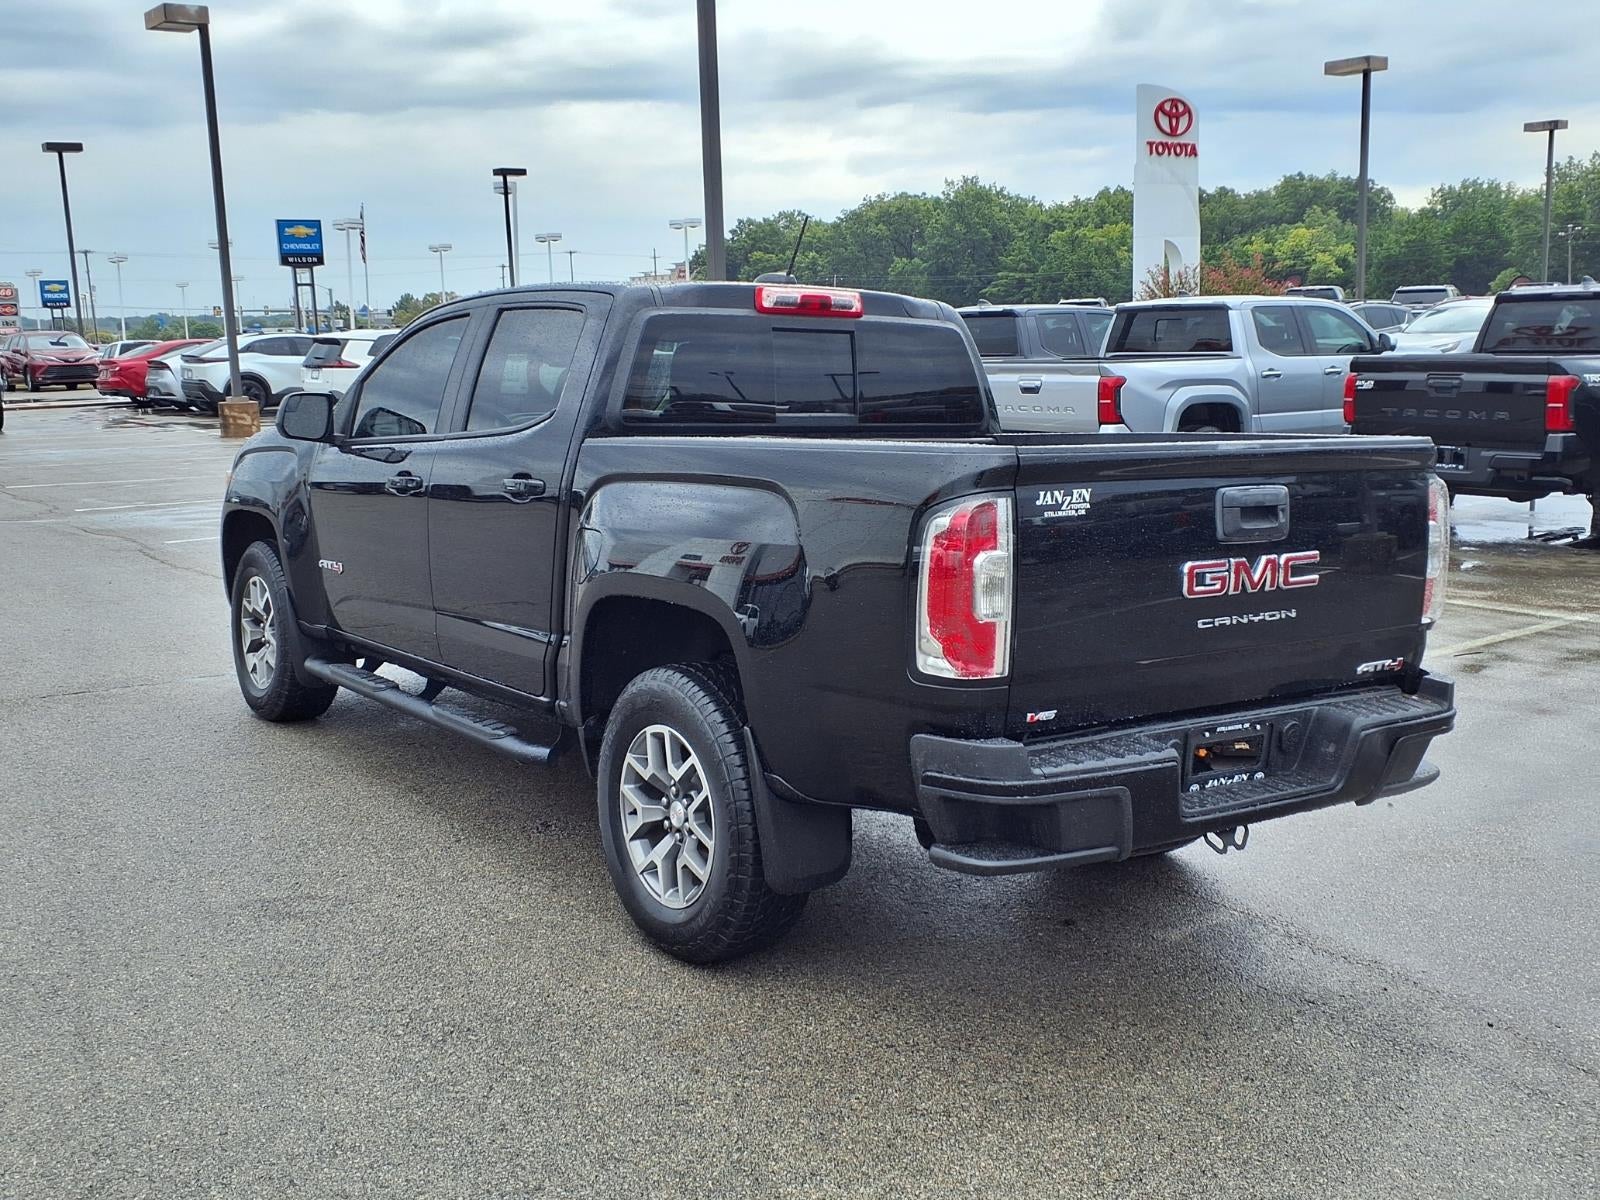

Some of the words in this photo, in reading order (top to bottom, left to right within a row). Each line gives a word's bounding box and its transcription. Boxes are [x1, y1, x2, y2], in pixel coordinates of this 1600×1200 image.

[1146, 141, 1198, 158] TOYOTA
[1583, 373, 1600, 383] TR
[1381, 407, 1510, 421] TACOMA
[1035, 488, 1092, 510] JANZEN
[1070, 502, 1091, 510] TOYOTA
[318, 559, 343, 574] AT4
[1182, 550, 1320, 599] GMC
[1197, 608, 1297, 629] CANYON
[1356, 656, 1405, 675] AT4
[1026, 709, 1057, 723] V6
[1205, 773, 1250, 789] JANZEN
